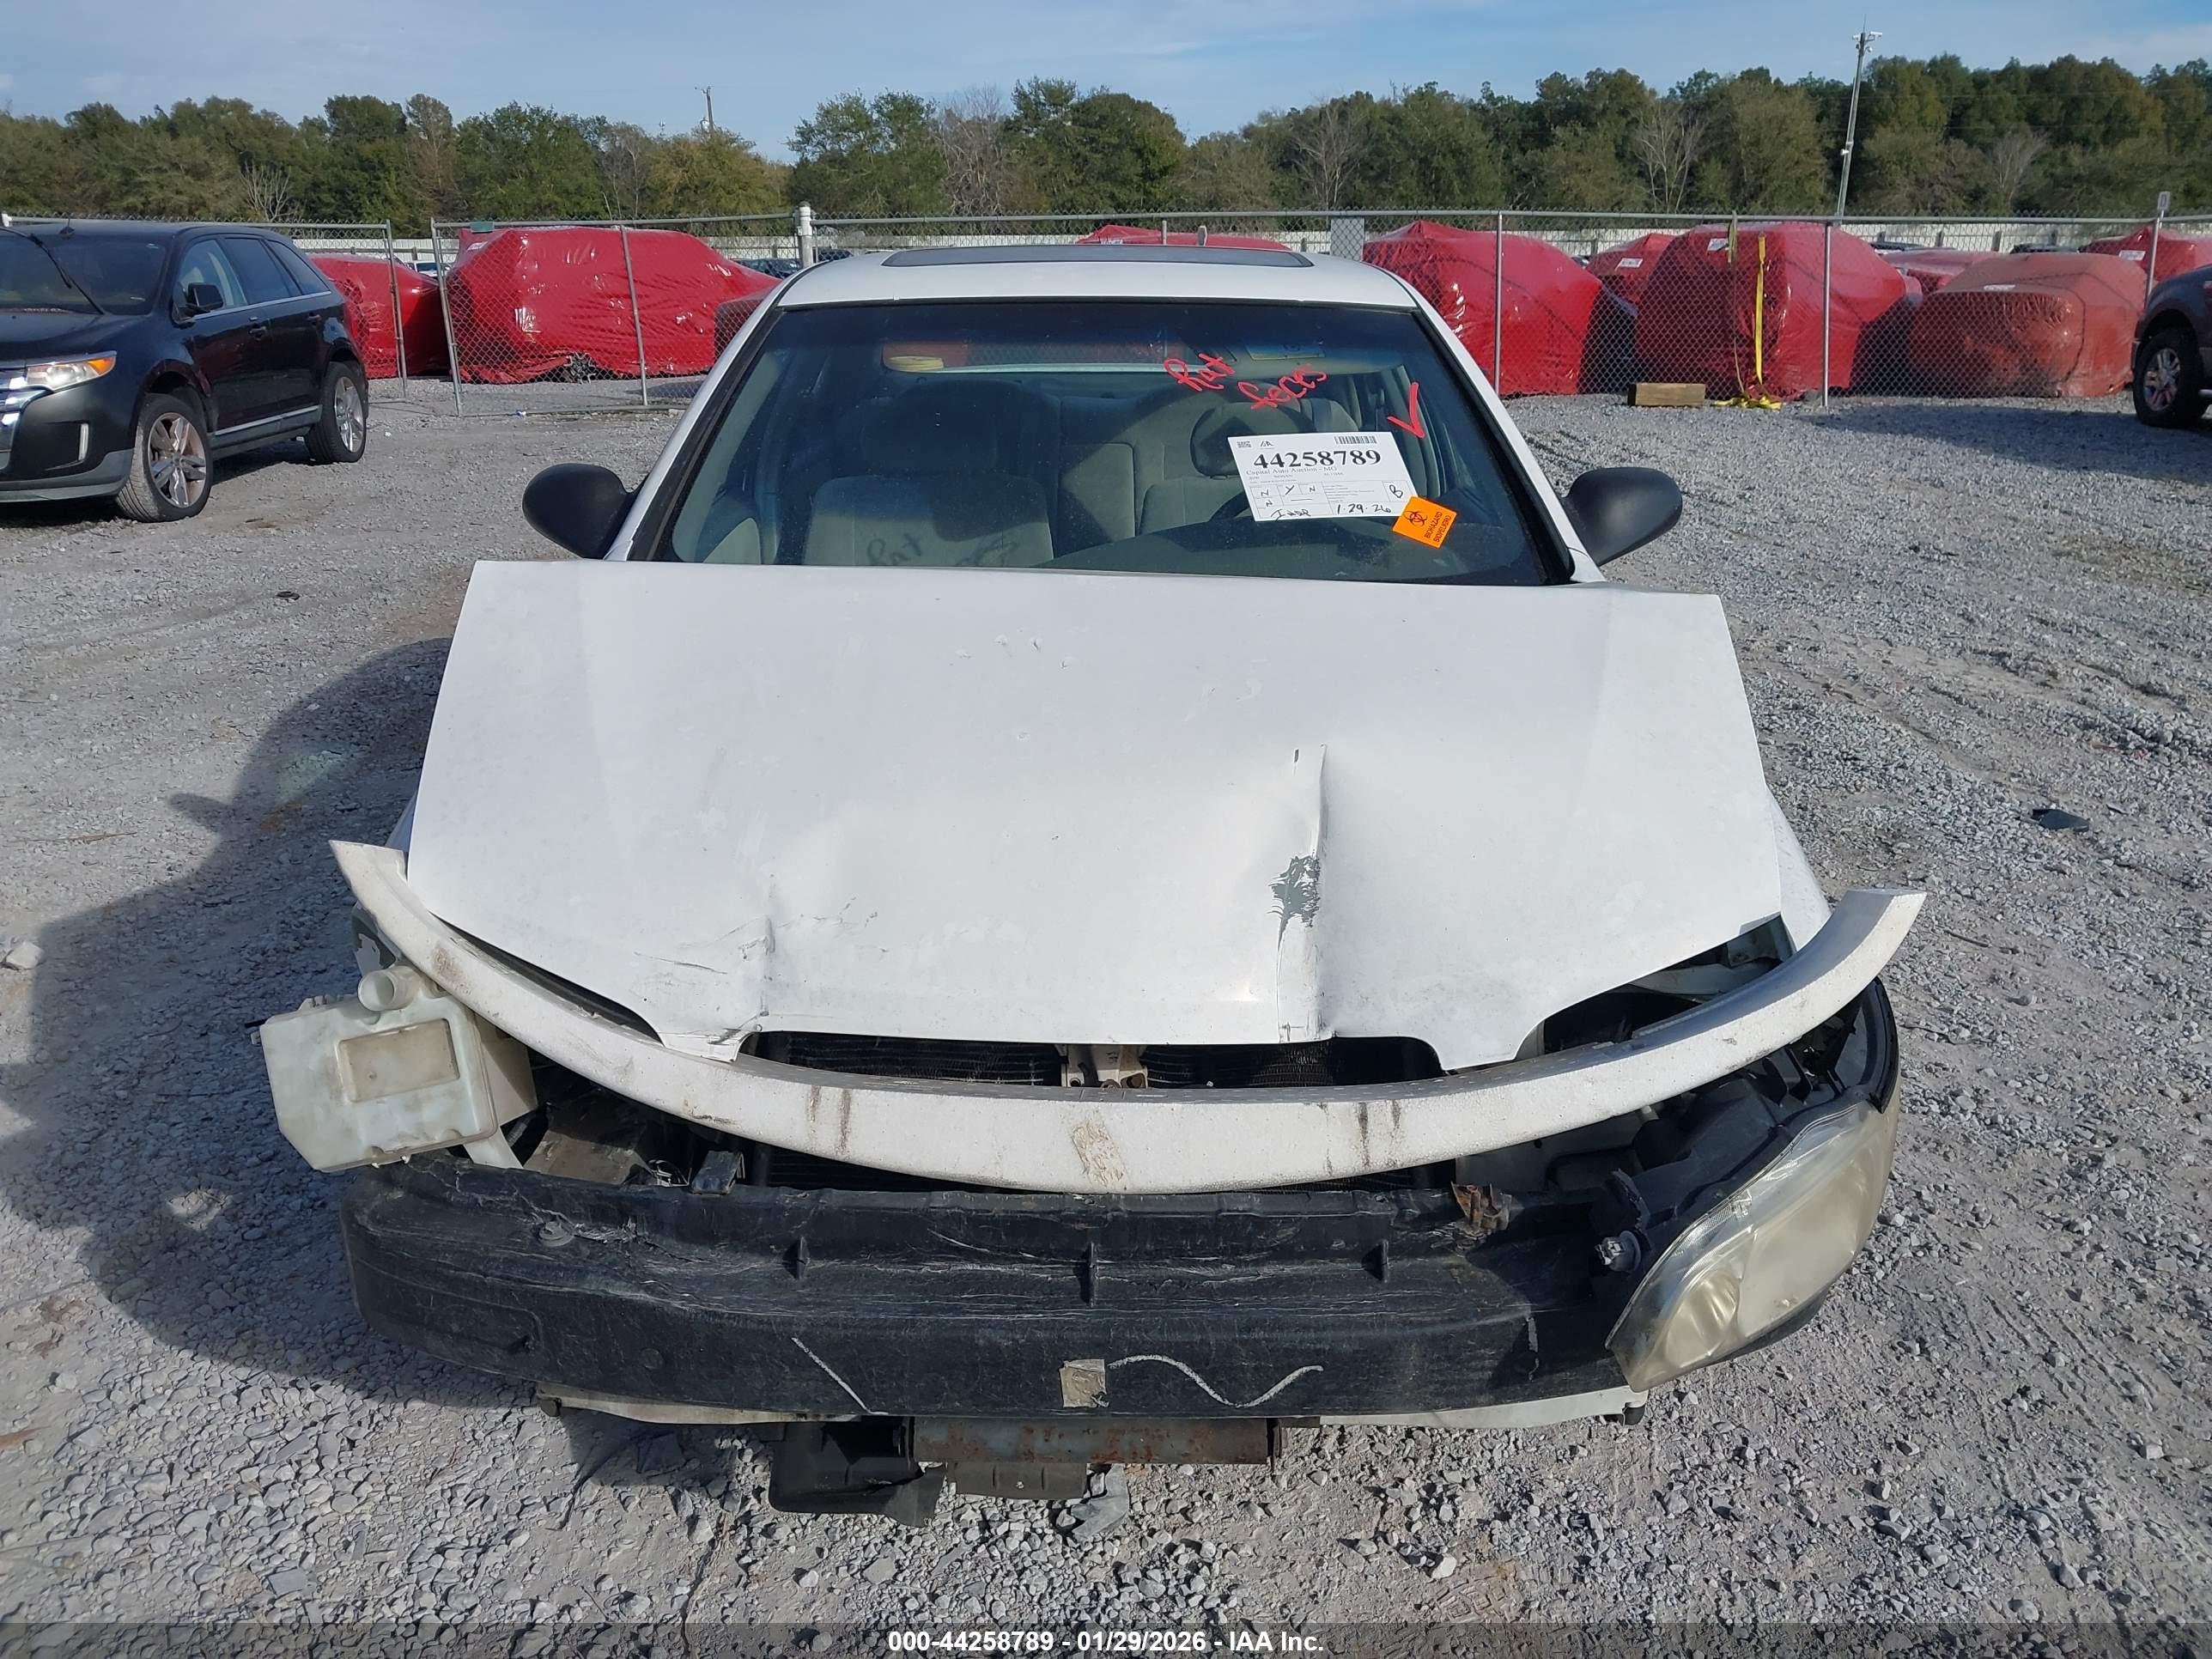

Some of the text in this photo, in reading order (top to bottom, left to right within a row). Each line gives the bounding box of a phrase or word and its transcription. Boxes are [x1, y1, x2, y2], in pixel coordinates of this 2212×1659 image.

[1164, 353, 1236, 392] Rat
[1254, 449, 1381, 469] 44258789
[1424, 511, 1443, 539] BIOHAZARD
